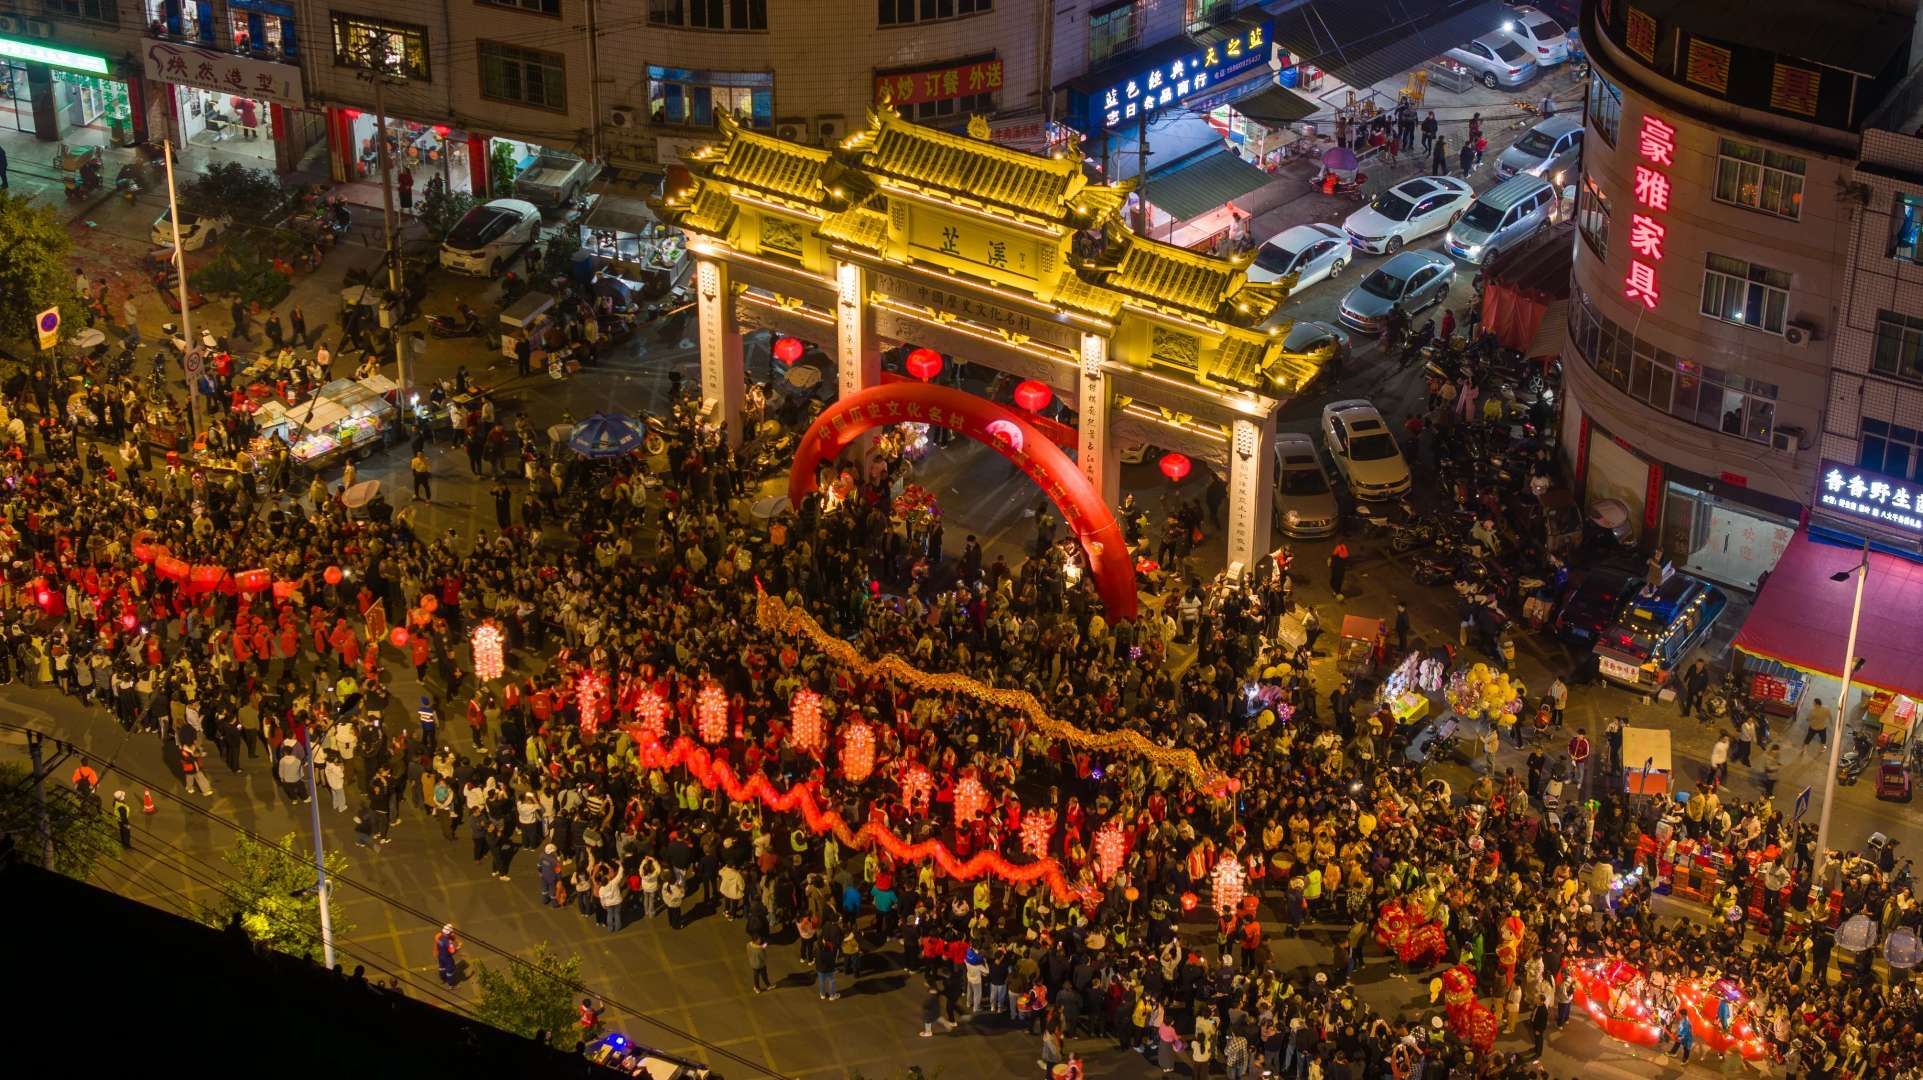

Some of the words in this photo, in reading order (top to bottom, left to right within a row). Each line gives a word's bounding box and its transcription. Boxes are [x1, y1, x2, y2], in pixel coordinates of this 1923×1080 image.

[924, 70, 960, 97] 订餐
[969, 63, 1002, 90] 外送
[1625, 115, 1674, 308] 豪雅家具
[939, 226, 1008, 268] 芷溪
